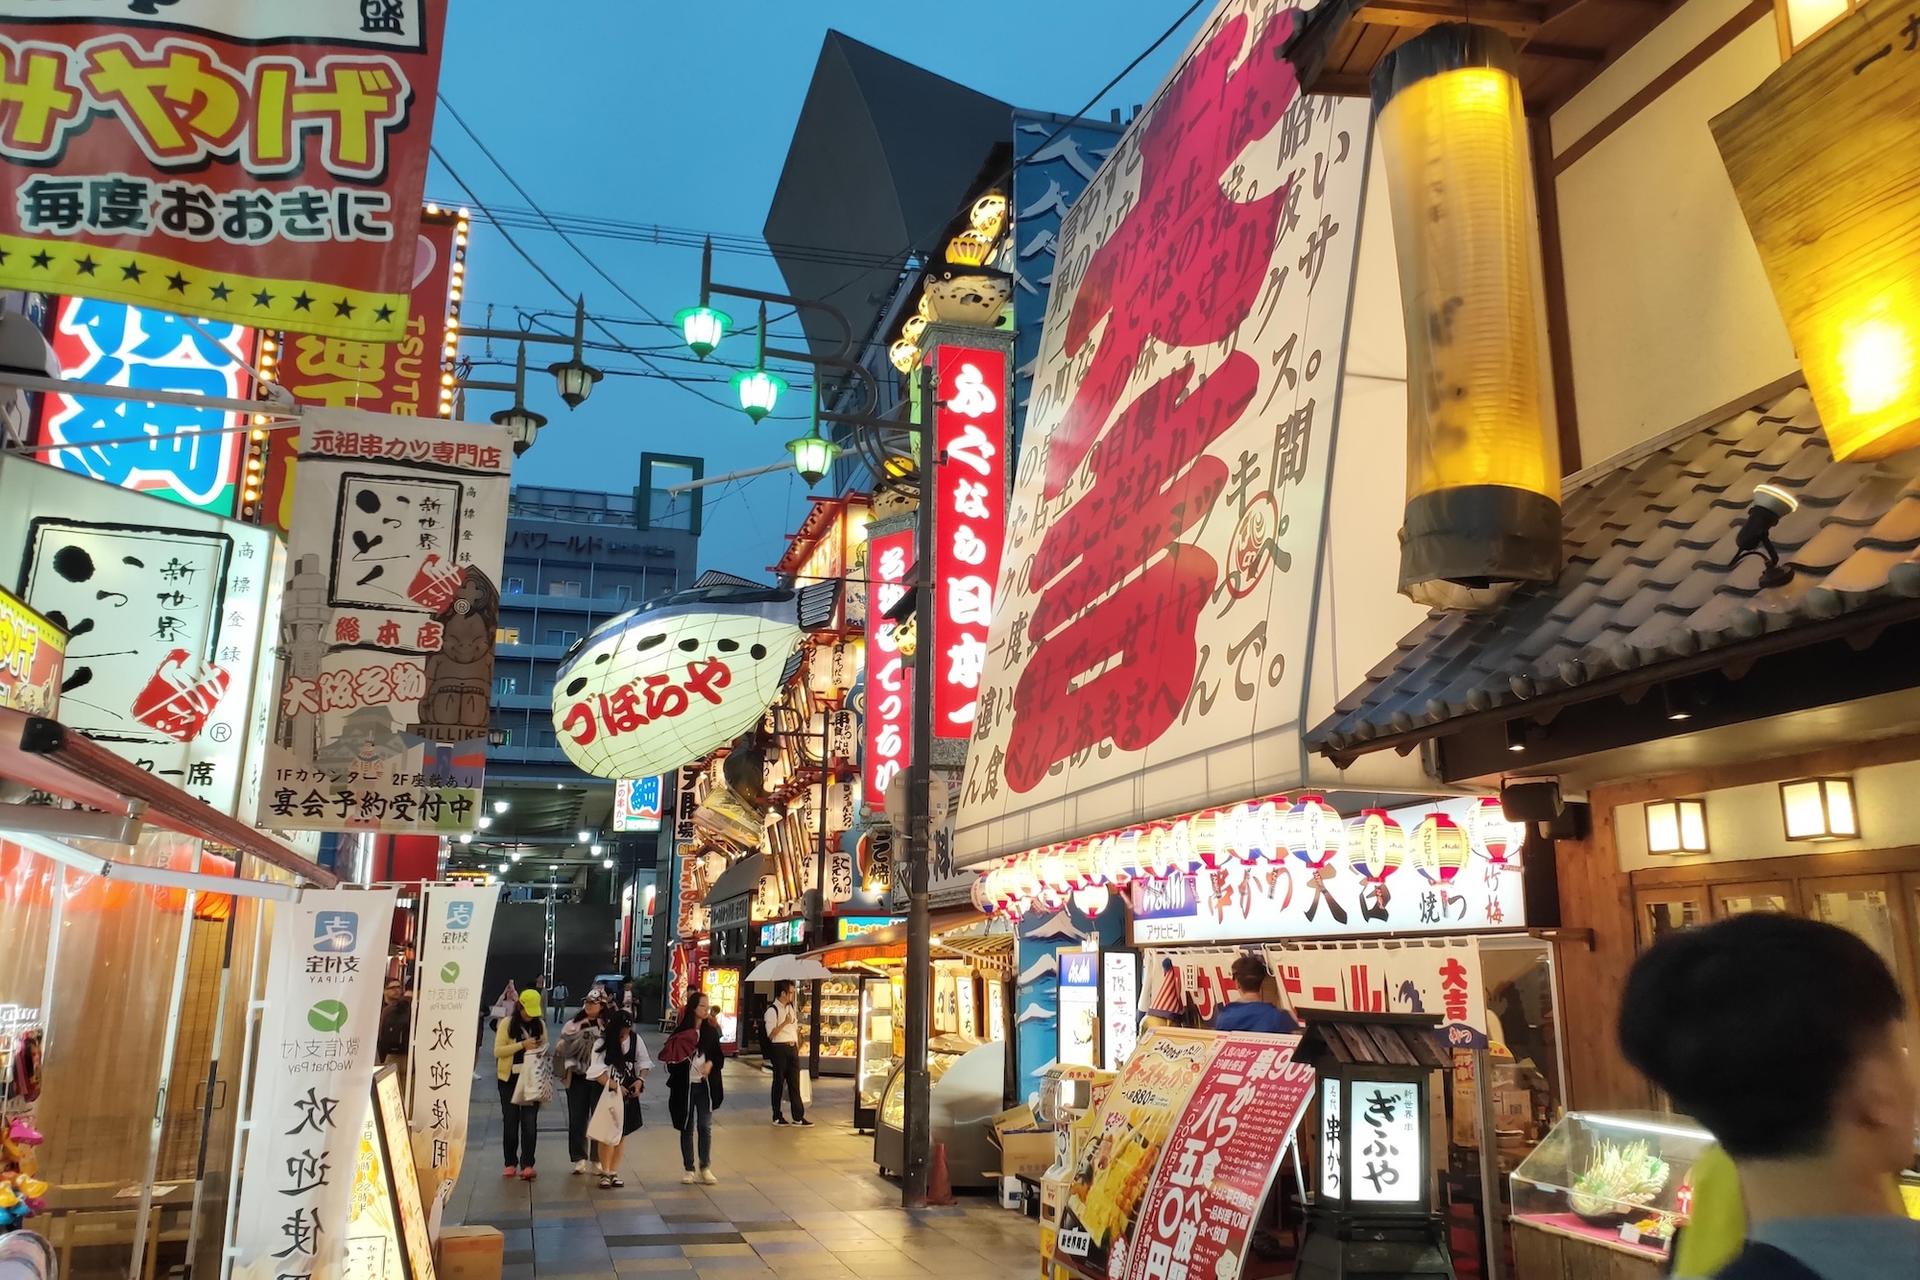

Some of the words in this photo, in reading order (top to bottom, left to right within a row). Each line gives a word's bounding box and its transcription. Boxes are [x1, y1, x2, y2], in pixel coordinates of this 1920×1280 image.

[22, 179, 390, 240] 毎度おおきに
[311, 430, 502, 468] 元祖串カツ専門店
[416, 496, 445, 551] 新世界
[946, 362, 998, 724] ふぐなら日本一
[150, 557, 206, 642] 新世界
[220, 541, 255, 662] 商標登録
[335, 617, 443, 649] 総本店
[283, 661, 427, 718] 大阪名物
[562, 655, 732, 746] づぼらや
[269, 786, 474, 823] 宴会予約受付中
[1370, 824, 1380, 863] アサヒビール
[1424, 827, 1434, 867] アサヒビール
[1147, 924, 1186, 940] アサヒビール
[1439, 957, 1468, 1021] 大吉
[1325, 1113, 1341, 1189] 串かつ
[1362, 1089, 1402, 1194] ぎふや
